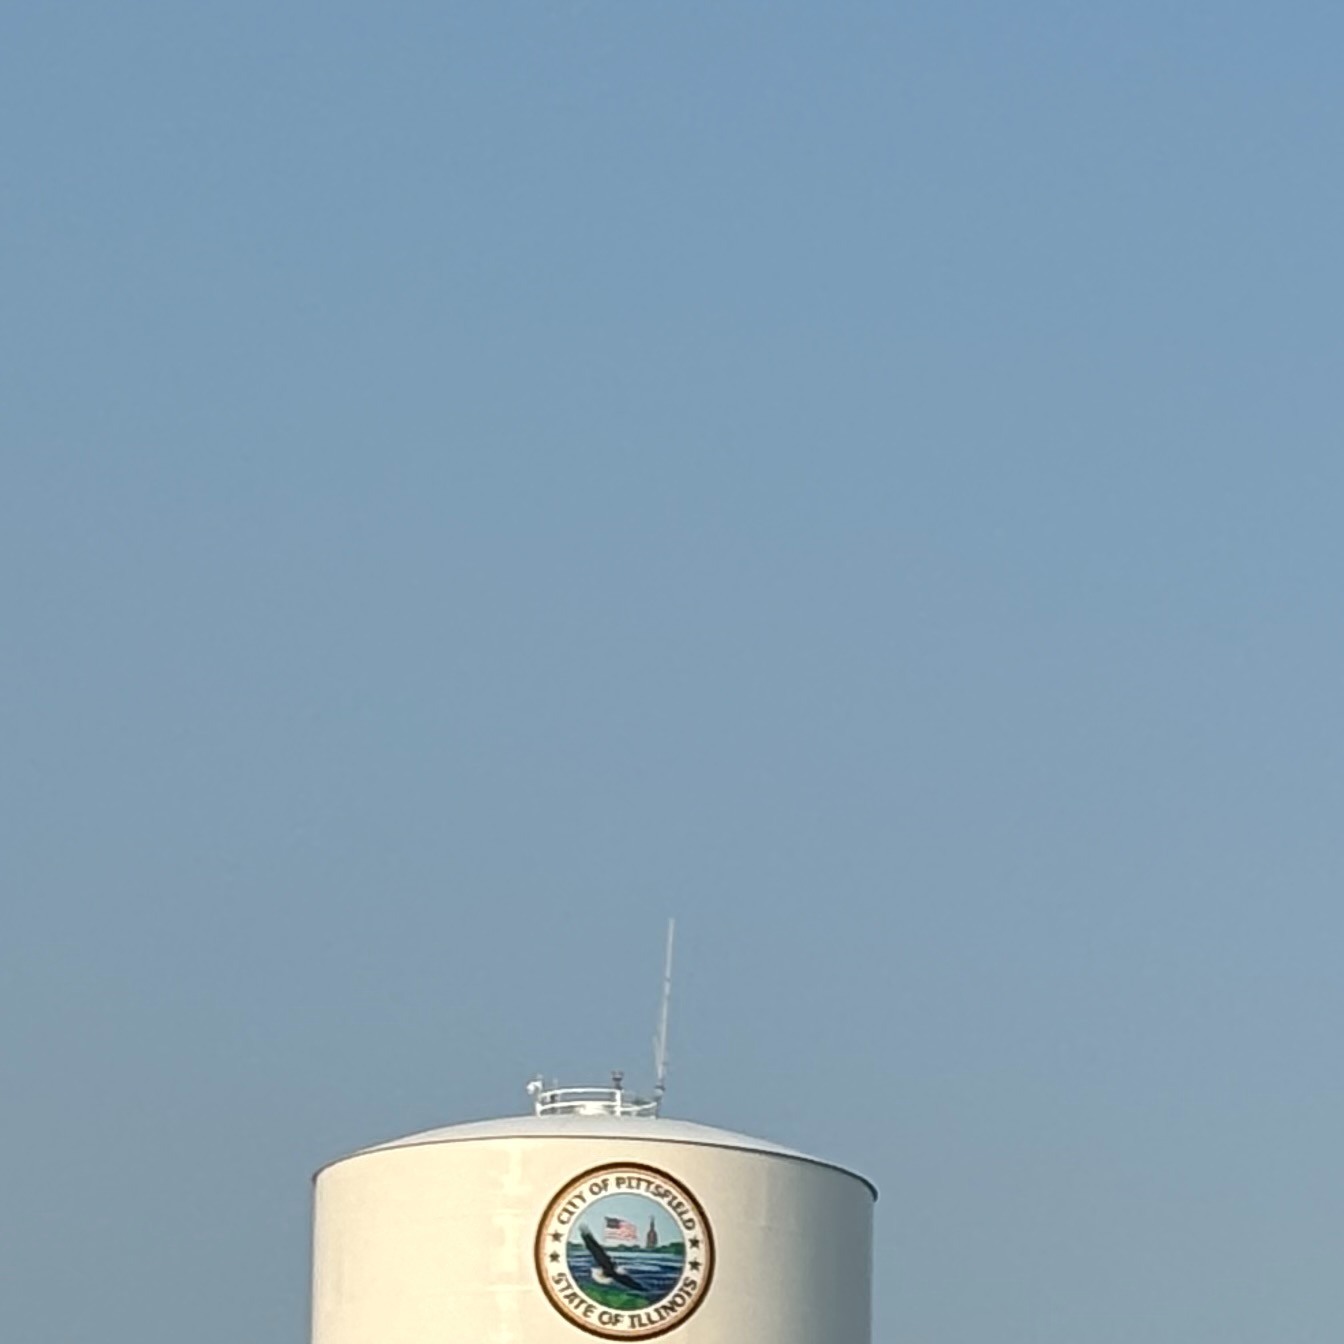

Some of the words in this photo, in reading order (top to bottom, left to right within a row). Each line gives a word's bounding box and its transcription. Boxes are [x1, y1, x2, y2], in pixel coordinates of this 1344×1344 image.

[557, 1191, 587, 1226] CITY
[589, 1178, 610, 1196] OF
[615, 1176, 696, 1231] PITTSFIELD
[552, 1272, 597, 1318] STATE
[598, 1310, 625, 1326] OF
[628, 1276, 698, 1329] ILLINOIS
